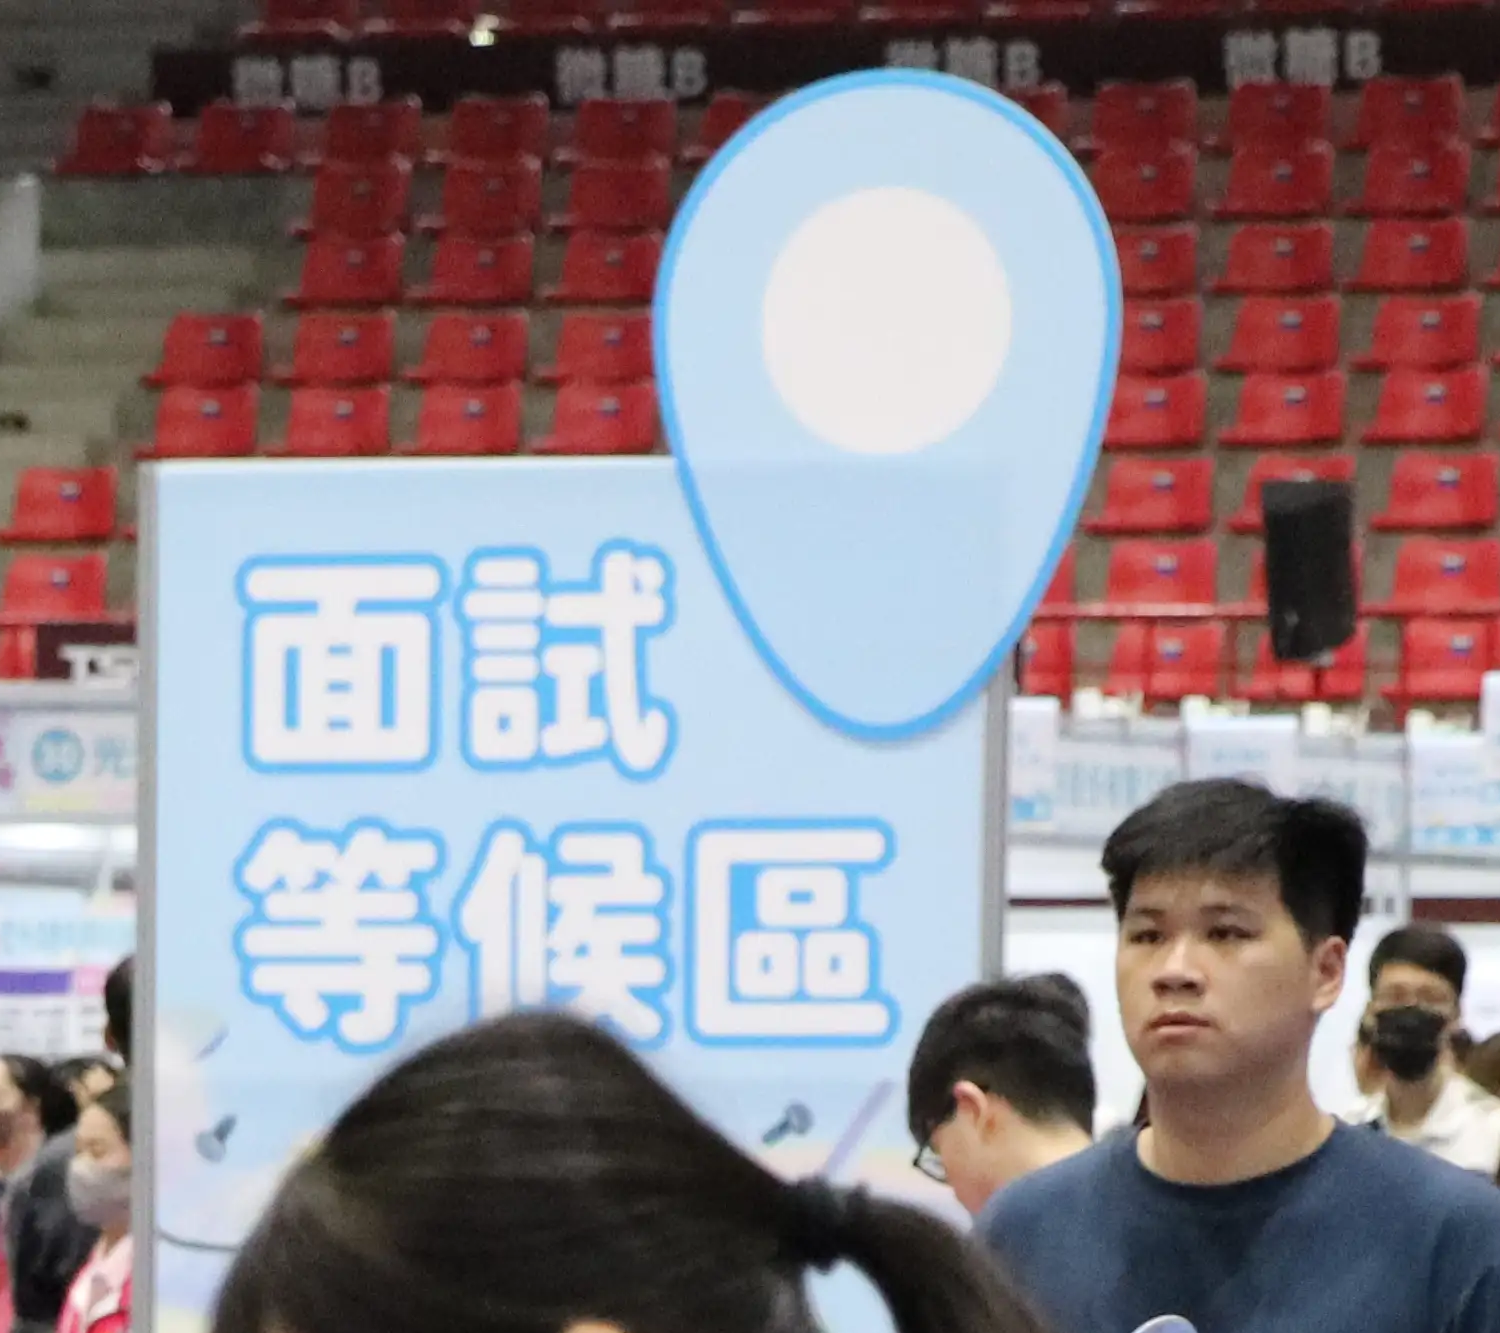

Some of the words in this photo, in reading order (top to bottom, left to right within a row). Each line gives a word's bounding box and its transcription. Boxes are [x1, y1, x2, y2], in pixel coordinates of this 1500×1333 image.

[237, 537, 675, 780] 面試
[236, 816, 899, 1052] 等候區
